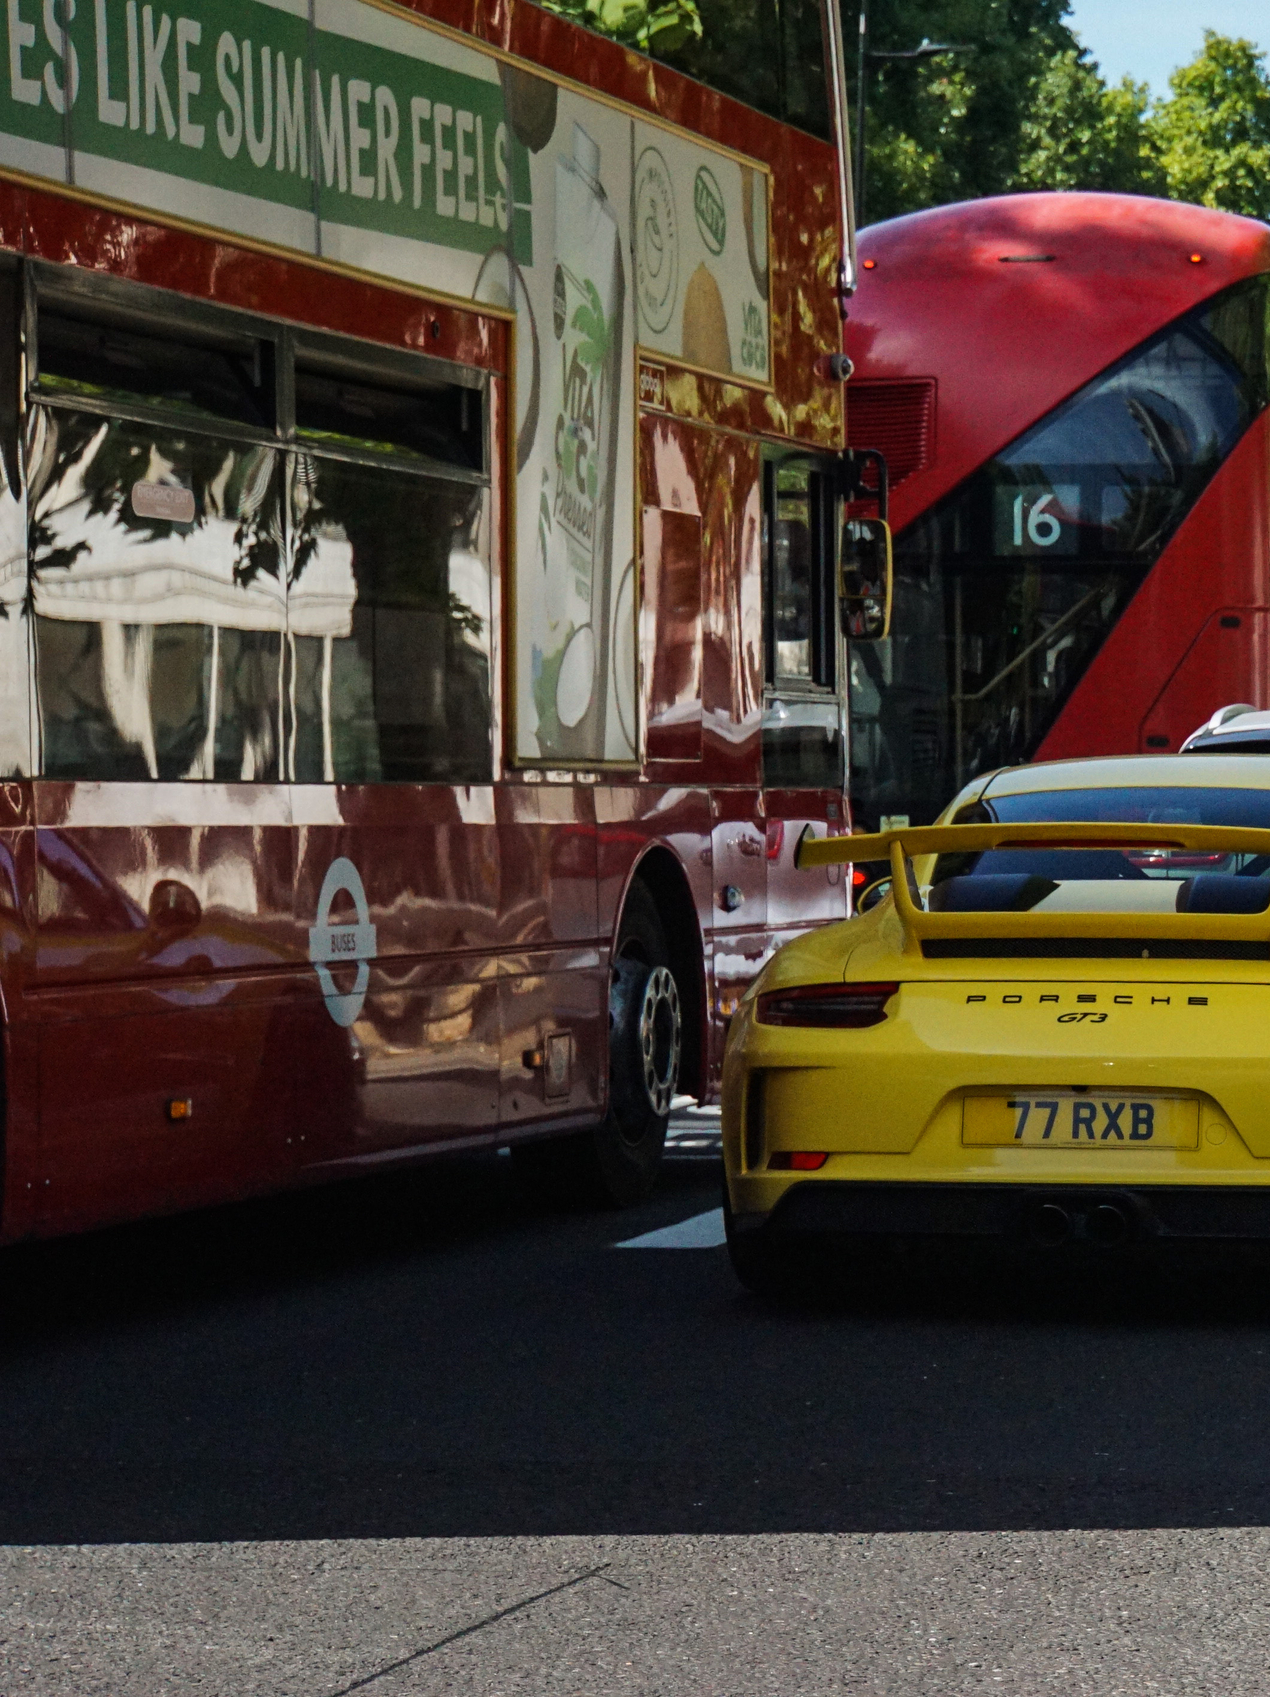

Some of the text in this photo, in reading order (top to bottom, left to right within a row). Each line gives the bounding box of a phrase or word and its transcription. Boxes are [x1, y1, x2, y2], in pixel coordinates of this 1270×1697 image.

[96, 0, 205, 149] LIKE
[217, 31, 402, 204] SUMMER
[411, 97, 511, 232] FEELS
[1013, 493, 1061, 546] 16
[331, 932, 356, 952] BUSES
[966, 994, 1209, 1006] PORSCHE
[1057, 1012, 1108, 1023] GT3
[1007, 1101, 1155, 1140] 77 RXB
